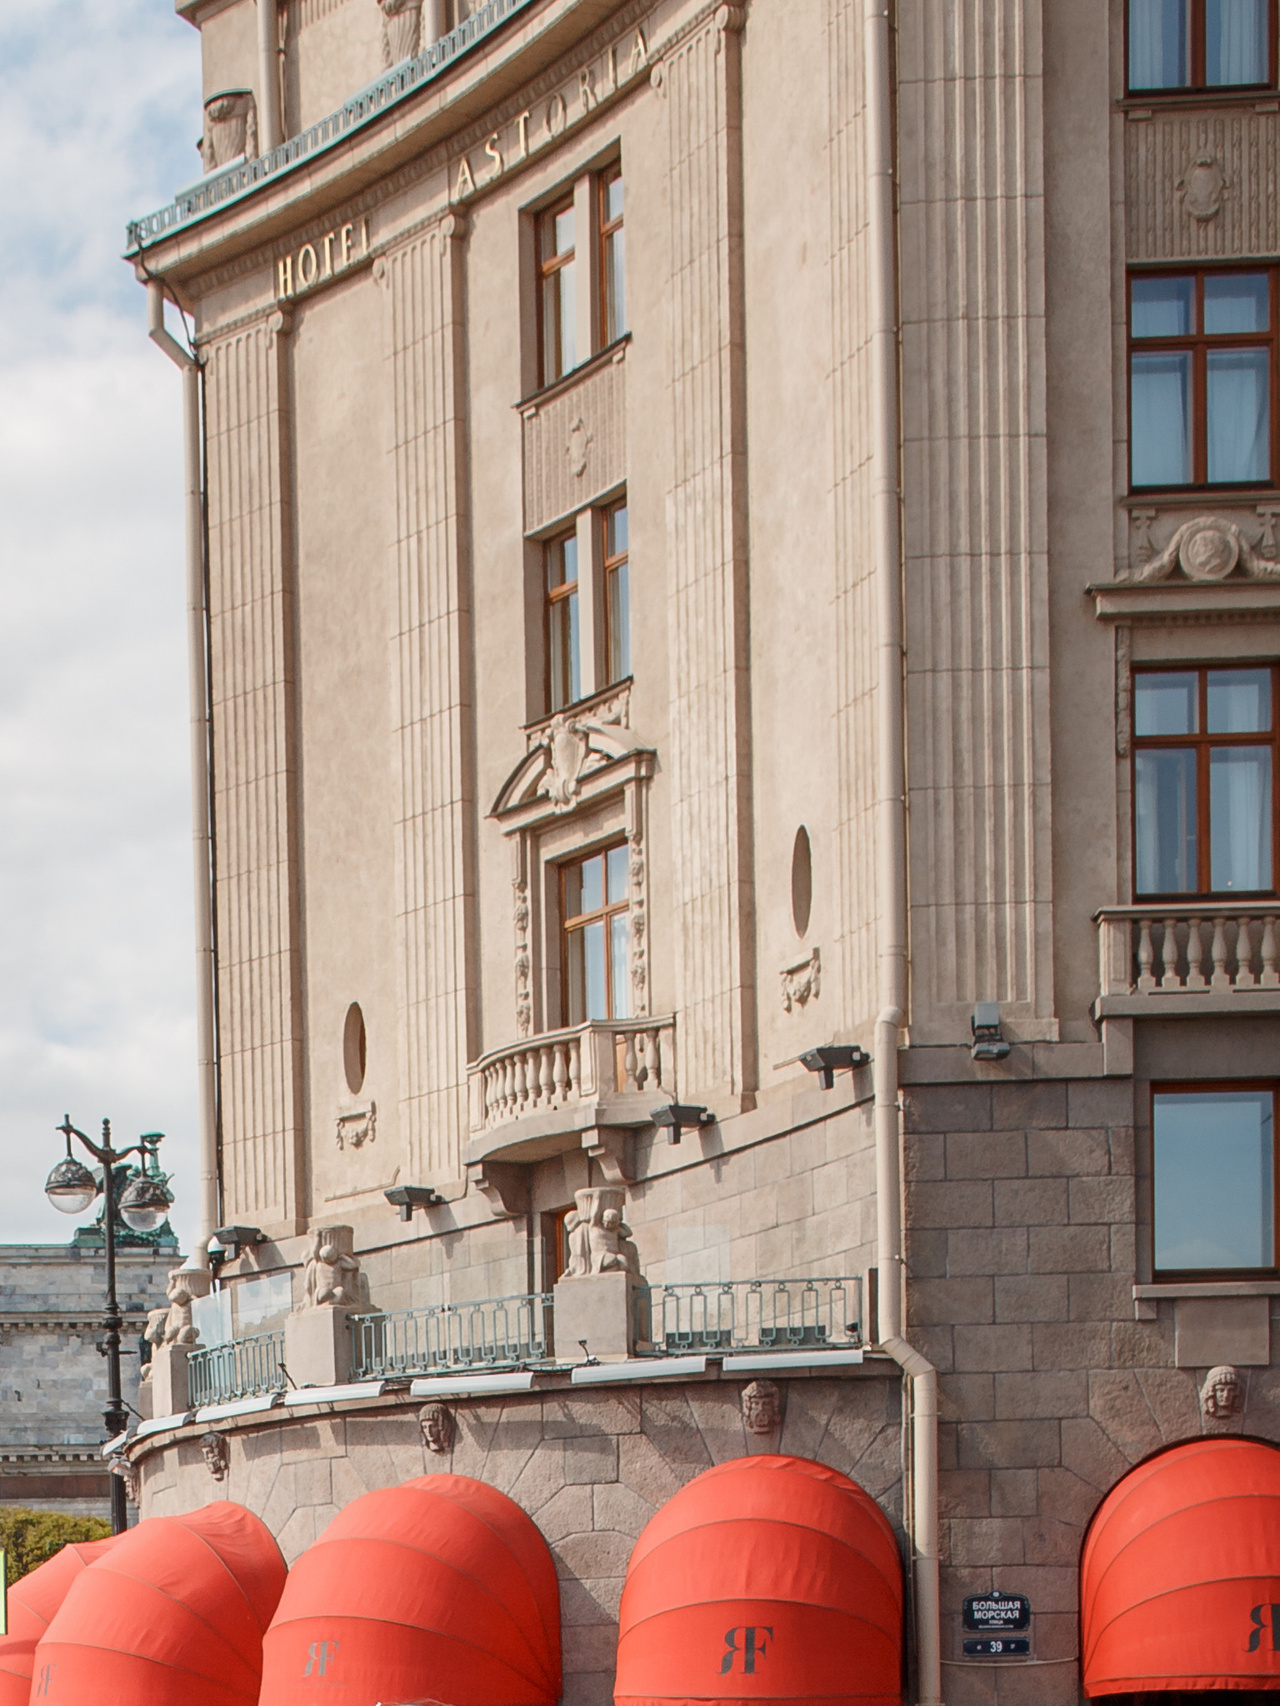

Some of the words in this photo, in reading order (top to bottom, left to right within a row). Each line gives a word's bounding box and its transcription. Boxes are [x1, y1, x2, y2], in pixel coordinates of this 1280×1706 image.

[277, 219, 368, 302] HOTEL
[450, 26, 648, 205] ASTORIA
[972, 1601, 1021, 1611] БОЛЬШАЯ
[973, 1610, 1020, 1620] МОРСКАЯ
[990, 1641, 1003, 1653] 39
